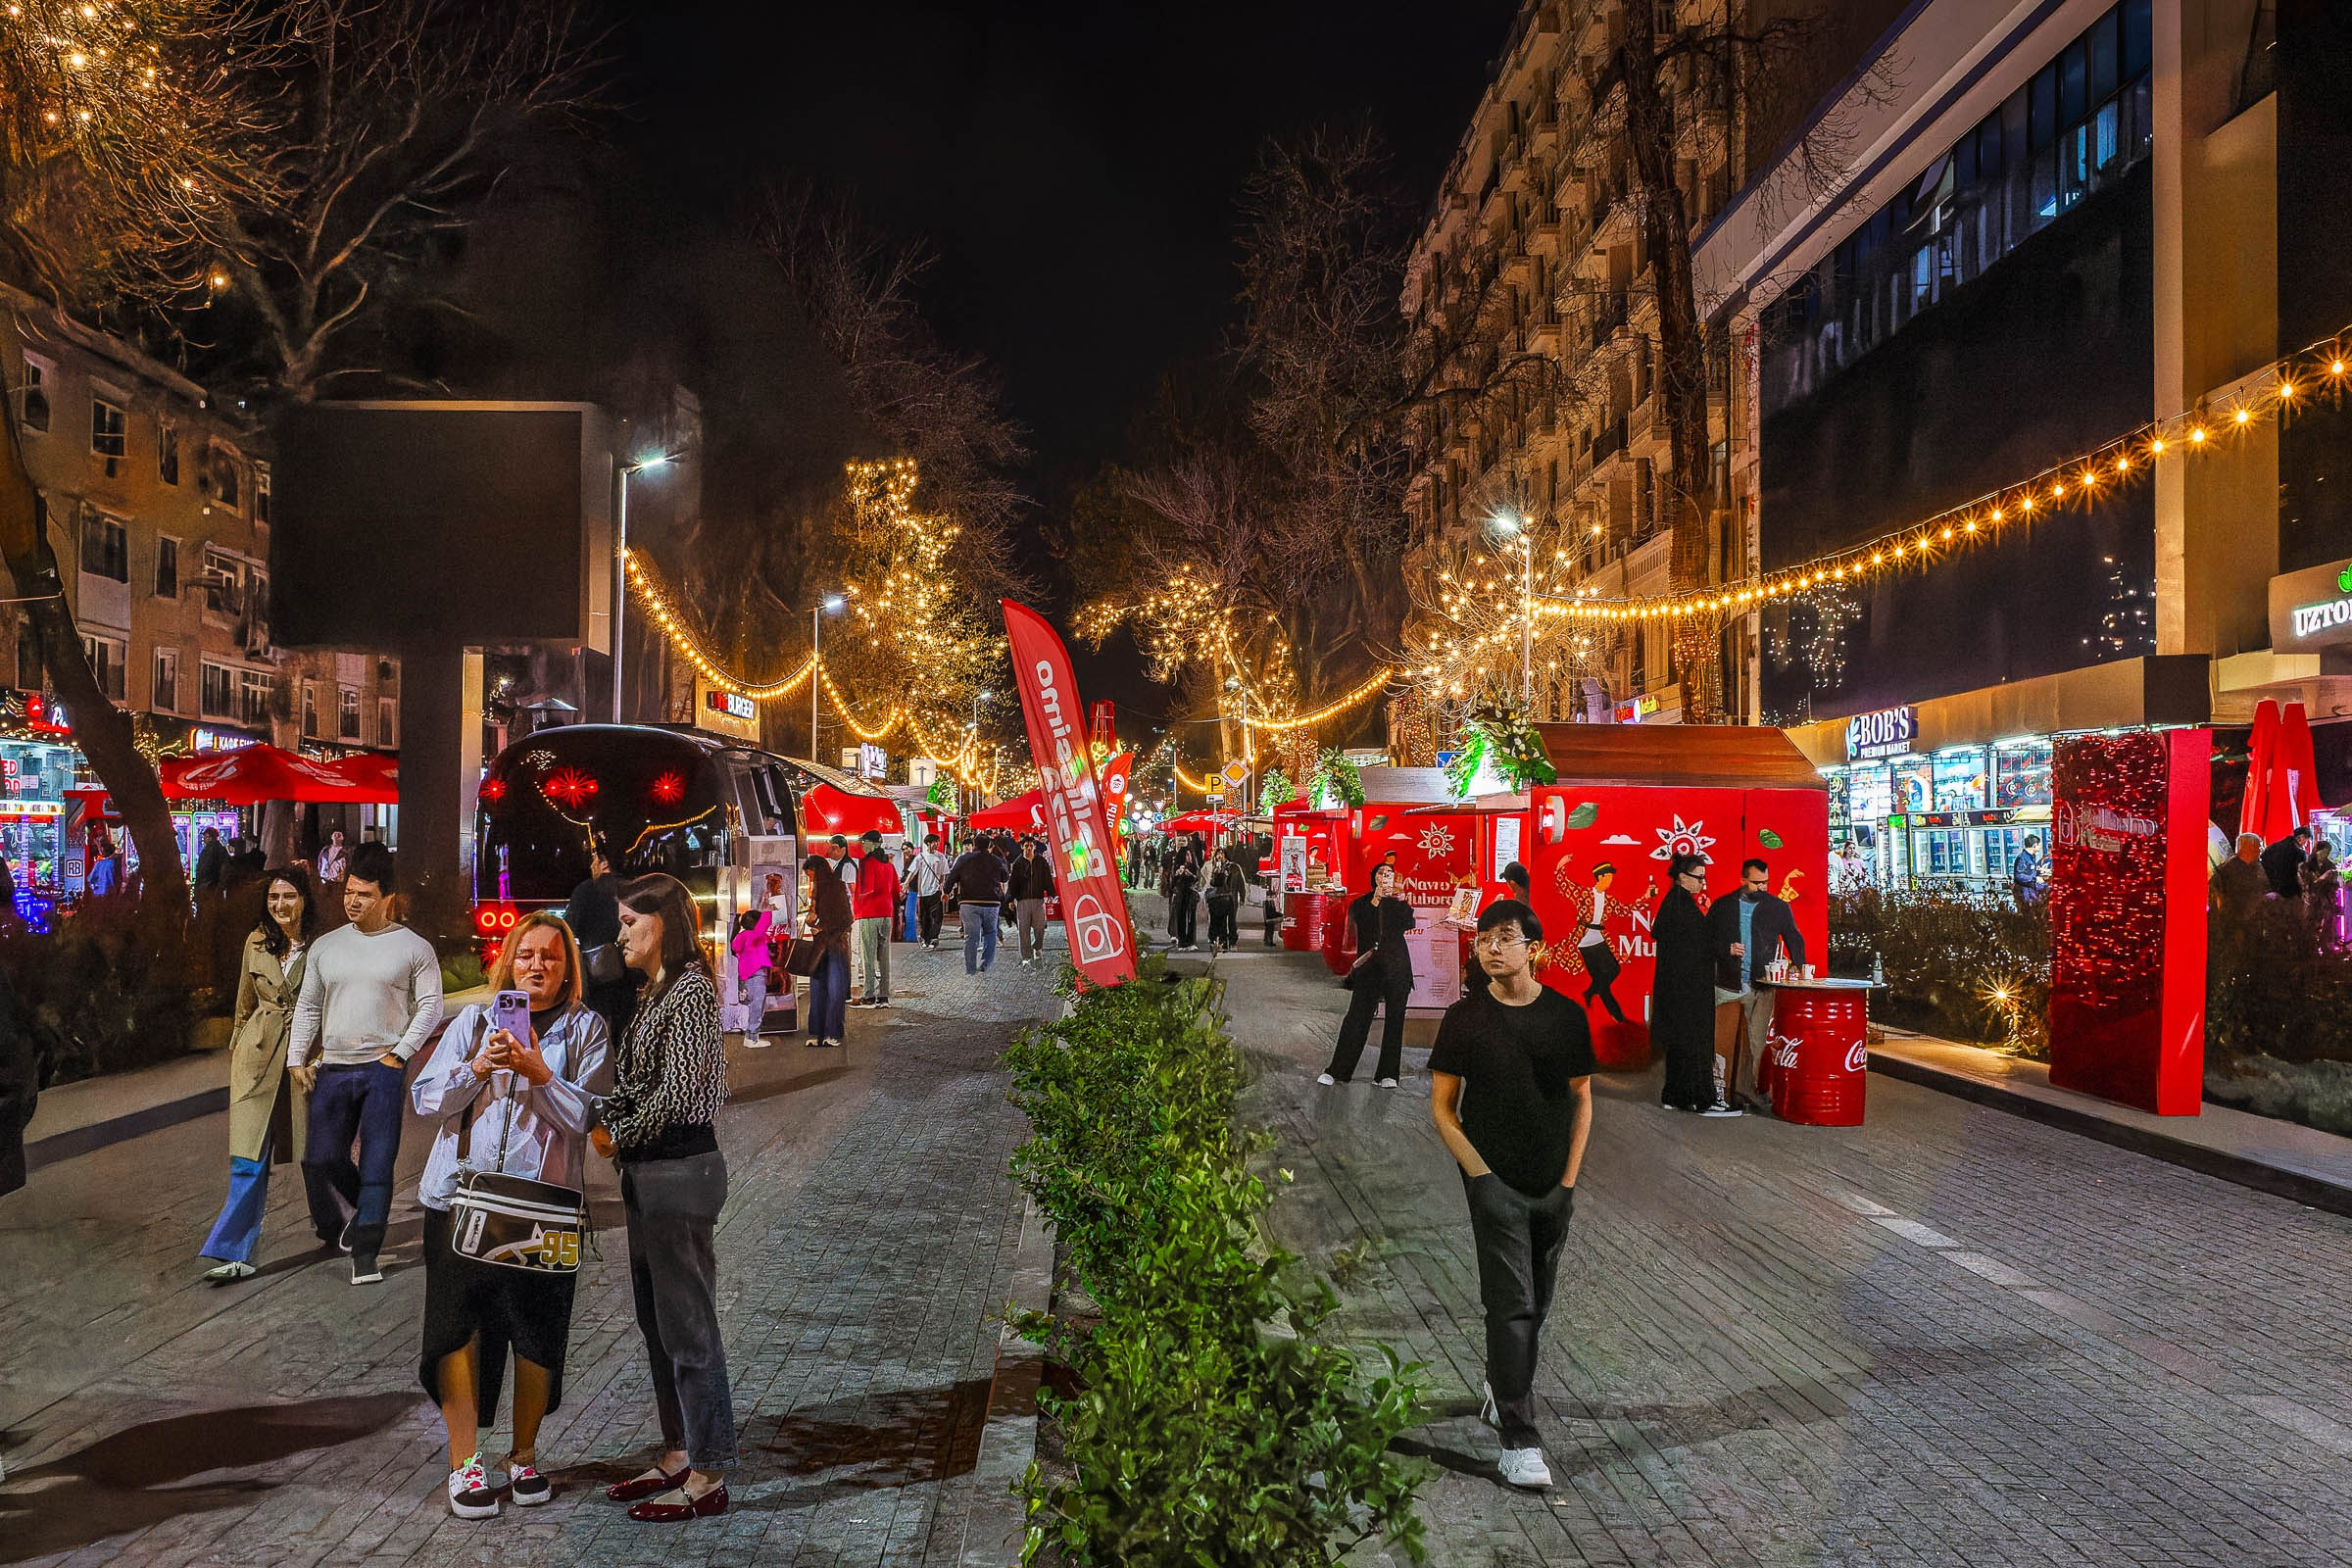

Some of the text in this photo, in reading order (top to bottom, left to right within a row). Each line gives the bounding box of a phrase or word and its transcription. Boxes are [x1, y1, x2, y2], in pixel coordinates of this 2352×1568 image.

[2294, 599, 2352, 636] UZTO
[728, 693, 754, 719] BURGER
[1860, 707, 1910, 746] BOB'S
[1861, 741, 1910, 759] PREMIUM MARKET
[1210, 776, 1222, 793] P
[69, 861, 81, 874] RB
[540, 1230, 578, 1265] 95
